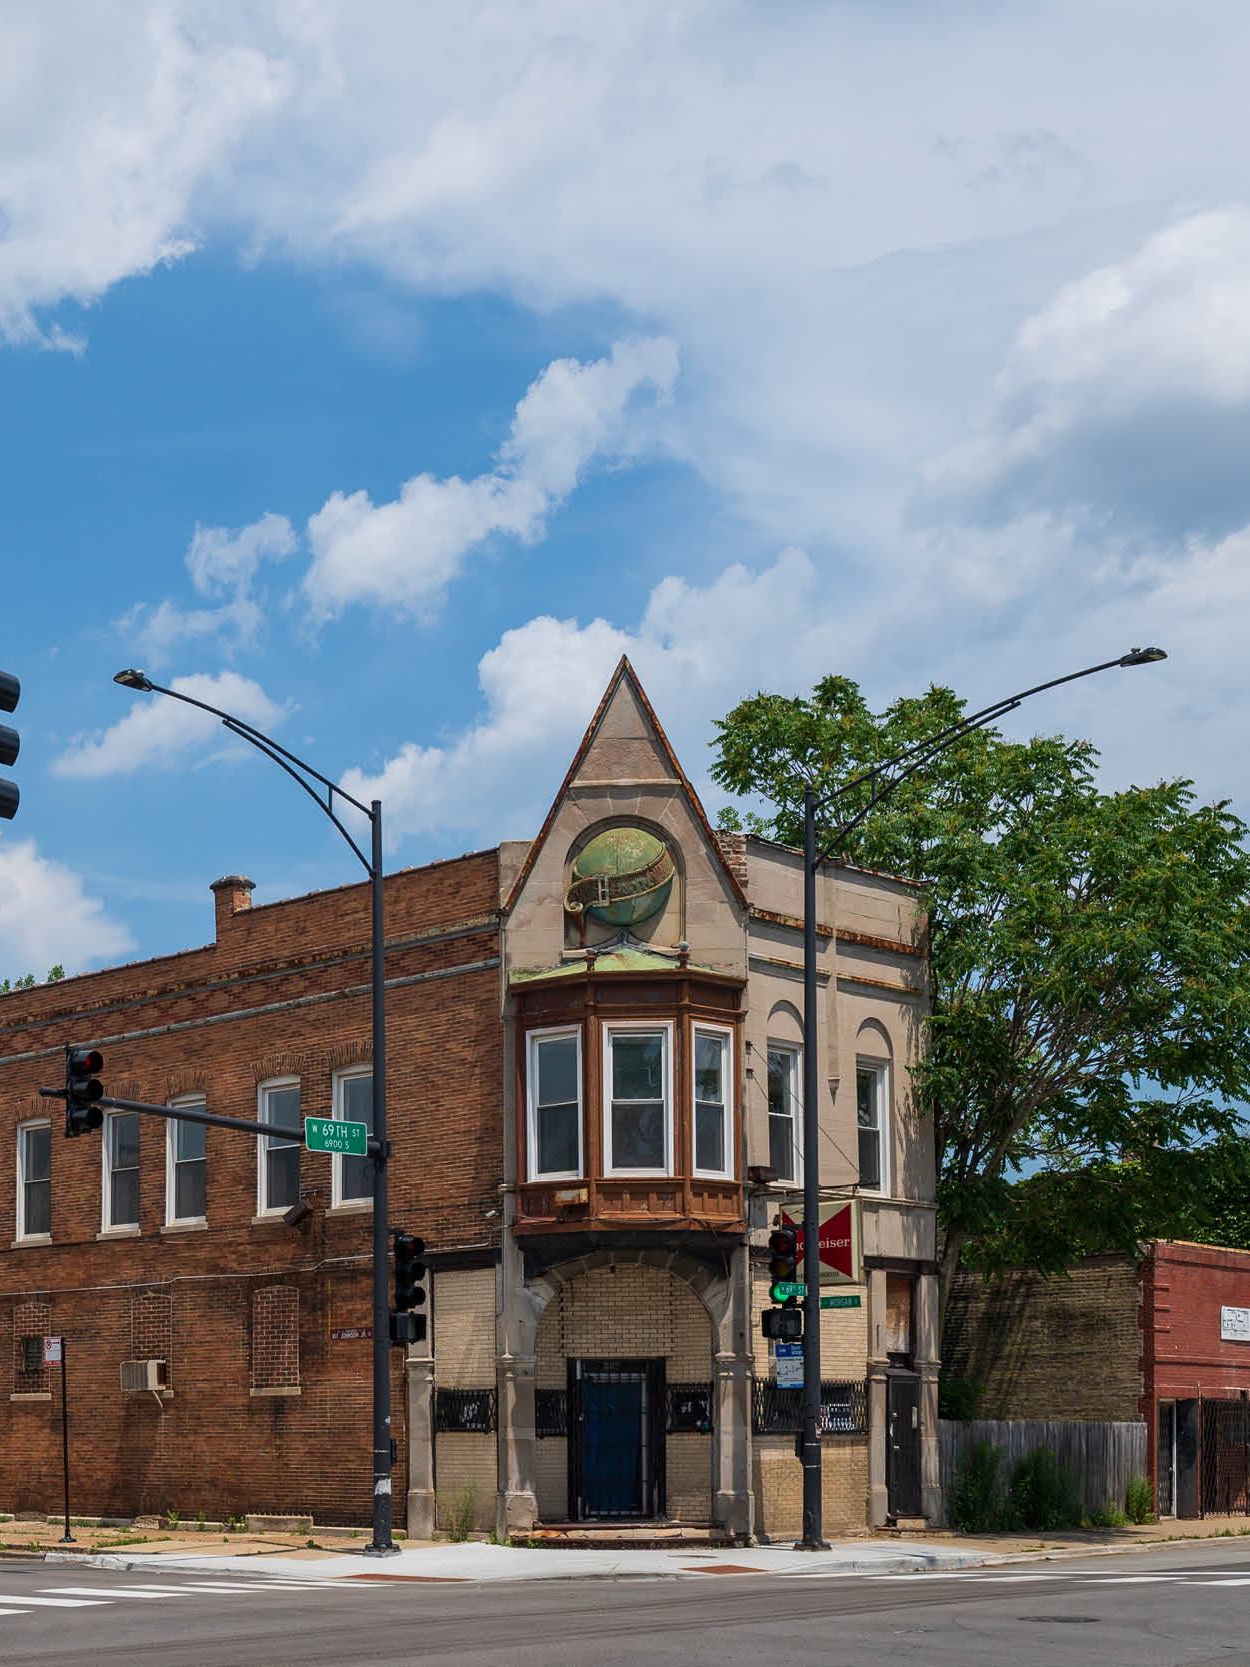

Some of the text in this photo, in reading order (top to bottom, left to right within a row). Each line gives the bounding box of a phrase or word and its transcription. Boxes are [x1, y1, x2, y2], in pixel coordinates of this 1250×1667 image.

[322, 1124, 348, 1138] 69TH
[352, 1128, 360, 1137] ST
[325, 1139, 350, 1150] 6900 S
